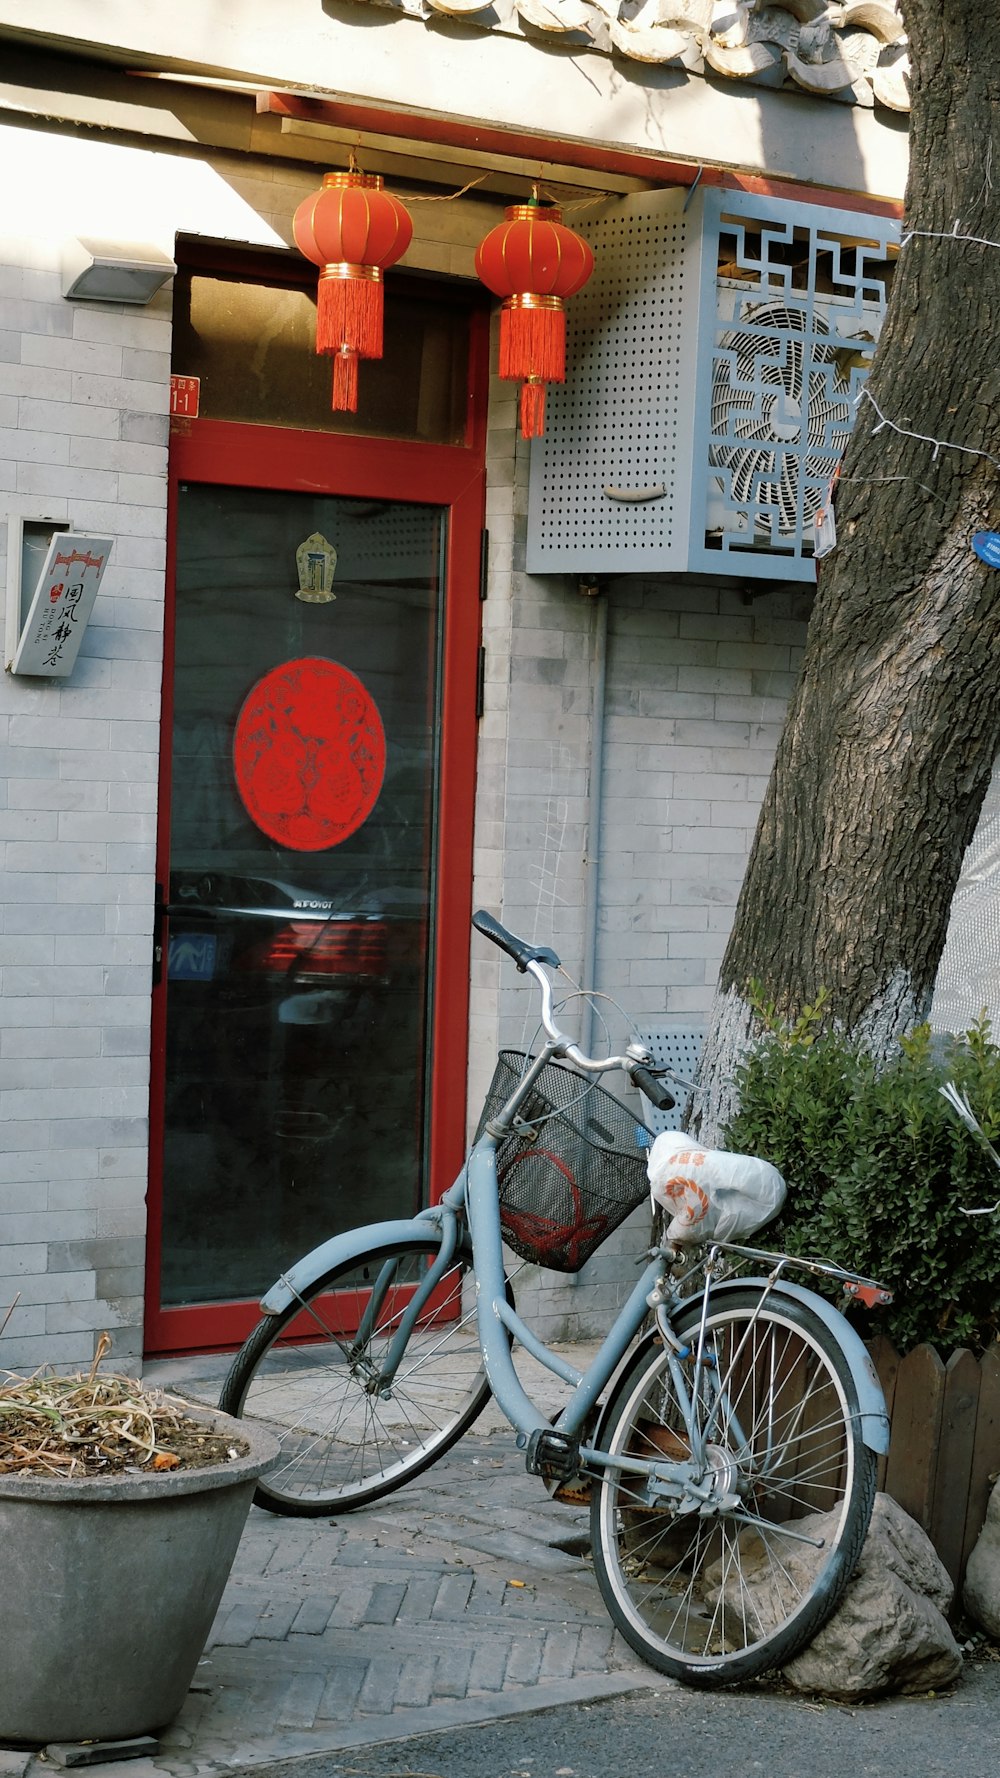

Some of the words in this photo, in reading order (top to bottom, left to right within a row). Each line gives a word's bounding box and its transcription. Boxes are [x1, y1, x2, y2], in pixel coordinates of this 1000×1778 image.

[43, 608, 50, 619] HU
[45, 608, 57, 631] DONG
[34, 622, 46, 644] TONG
